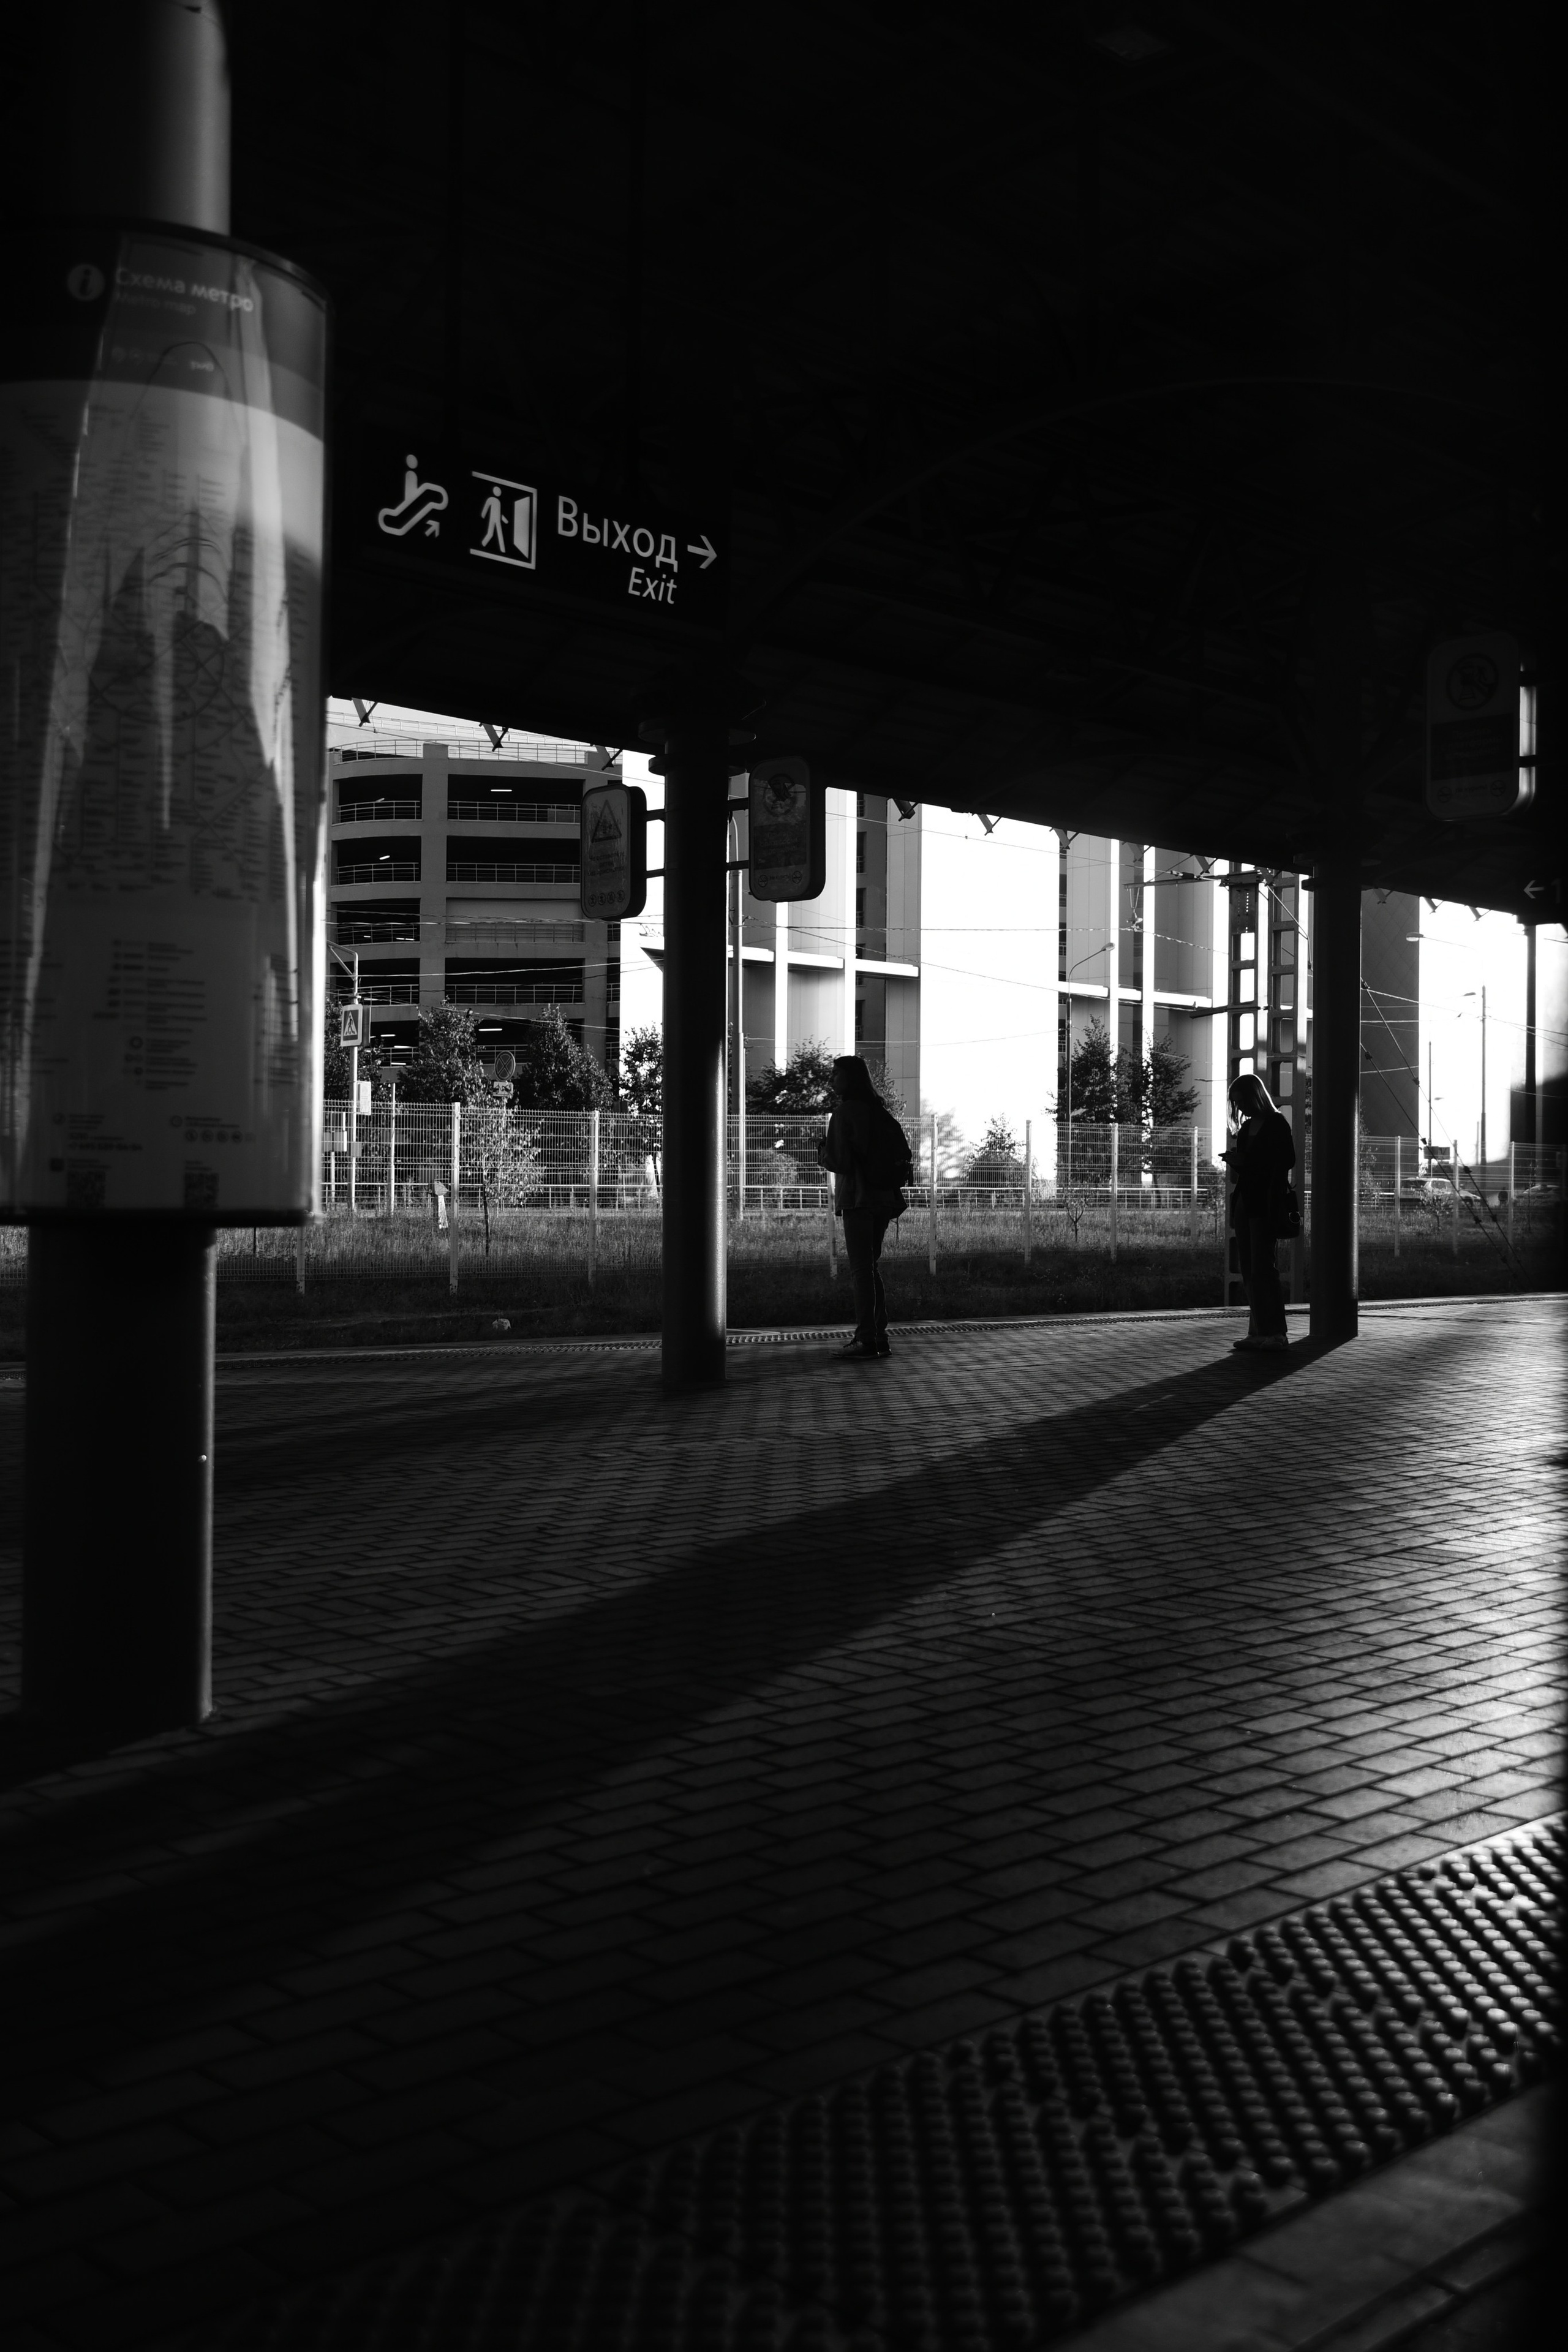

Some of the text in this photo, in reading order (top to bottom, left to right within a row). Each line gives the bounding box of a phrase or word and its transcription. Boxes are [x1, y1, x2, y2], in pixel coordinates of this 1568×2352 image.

[116, 267, 254, 312] Схема метро
[557, 494, 679, 573] Выход
[627, 566, 677, 605] Exit
